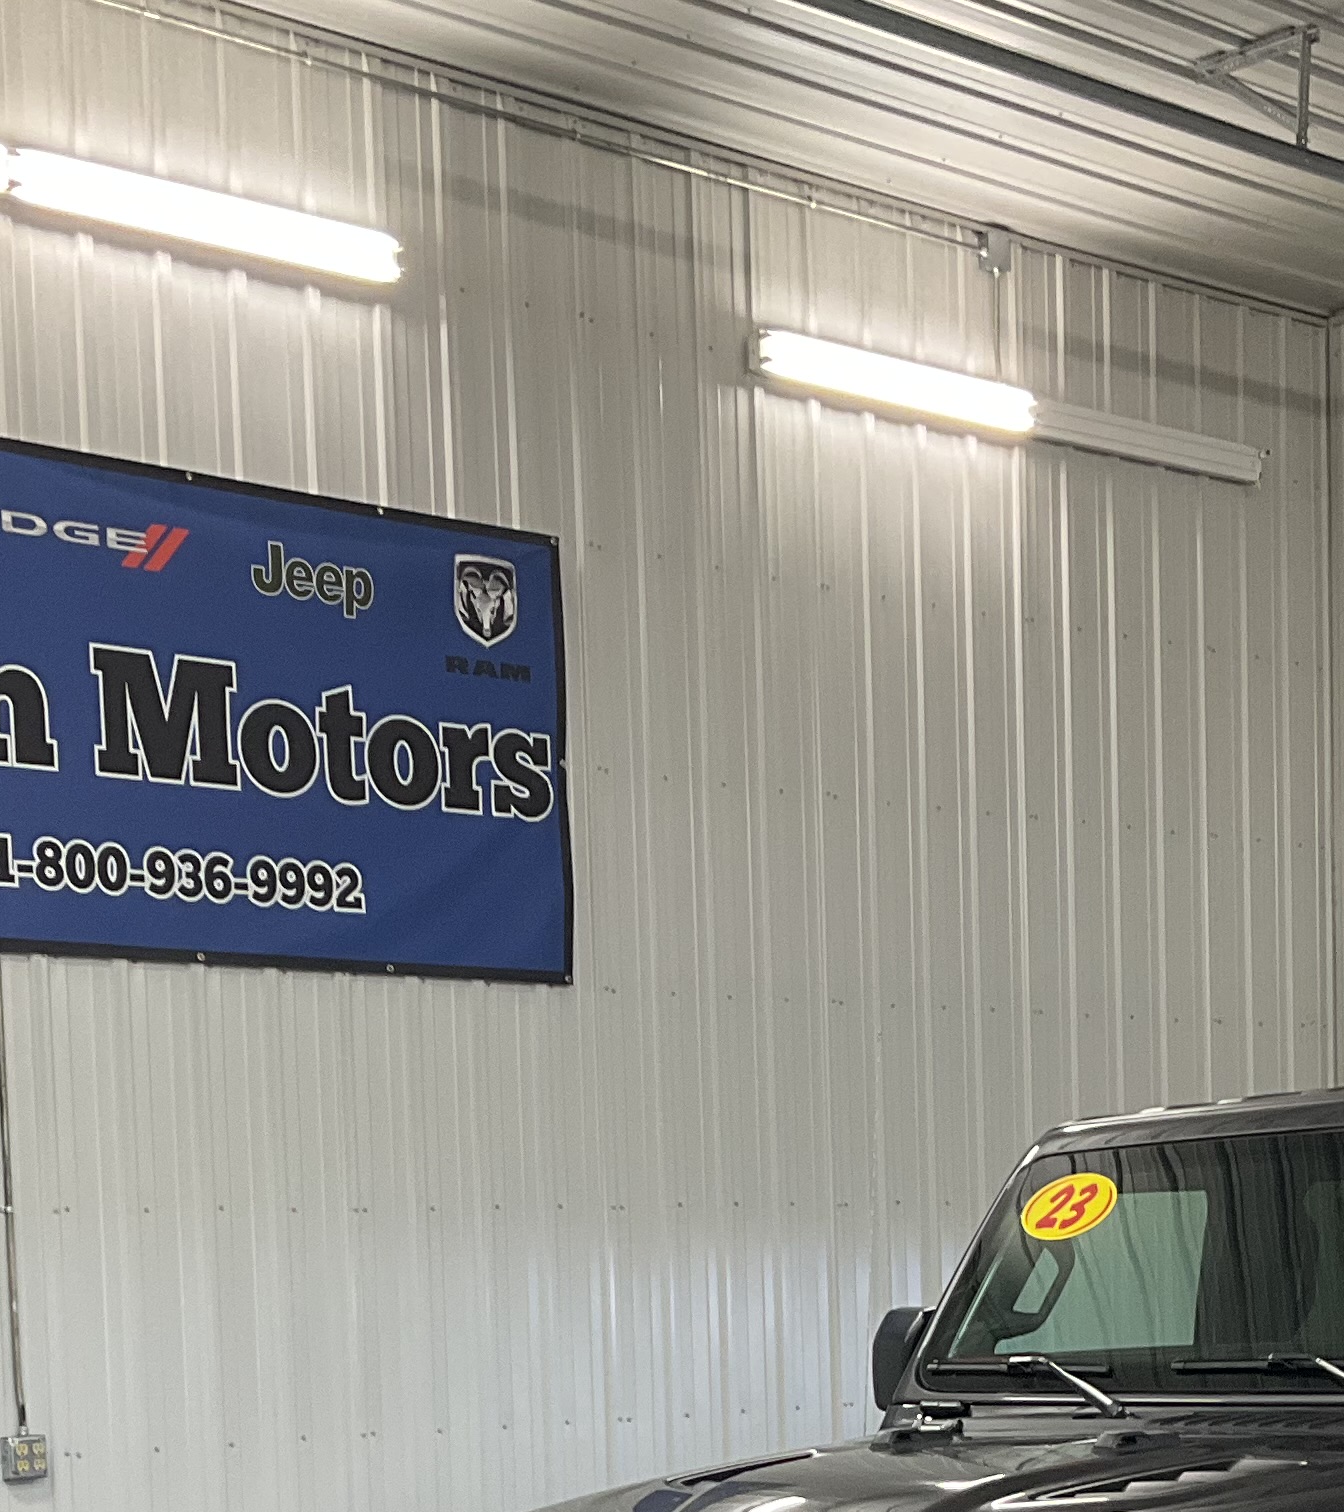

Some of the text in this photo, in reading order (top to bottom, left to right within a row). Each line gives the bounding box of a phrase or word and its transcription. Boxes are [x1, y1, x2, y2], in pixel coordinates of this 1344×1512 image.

[250, 539, 375, 619] Jeep
[445, 655, 532, 683] RAM
[89, 642, 554, 822] Motors
[1035, 1183, 1099, 1230] 23
